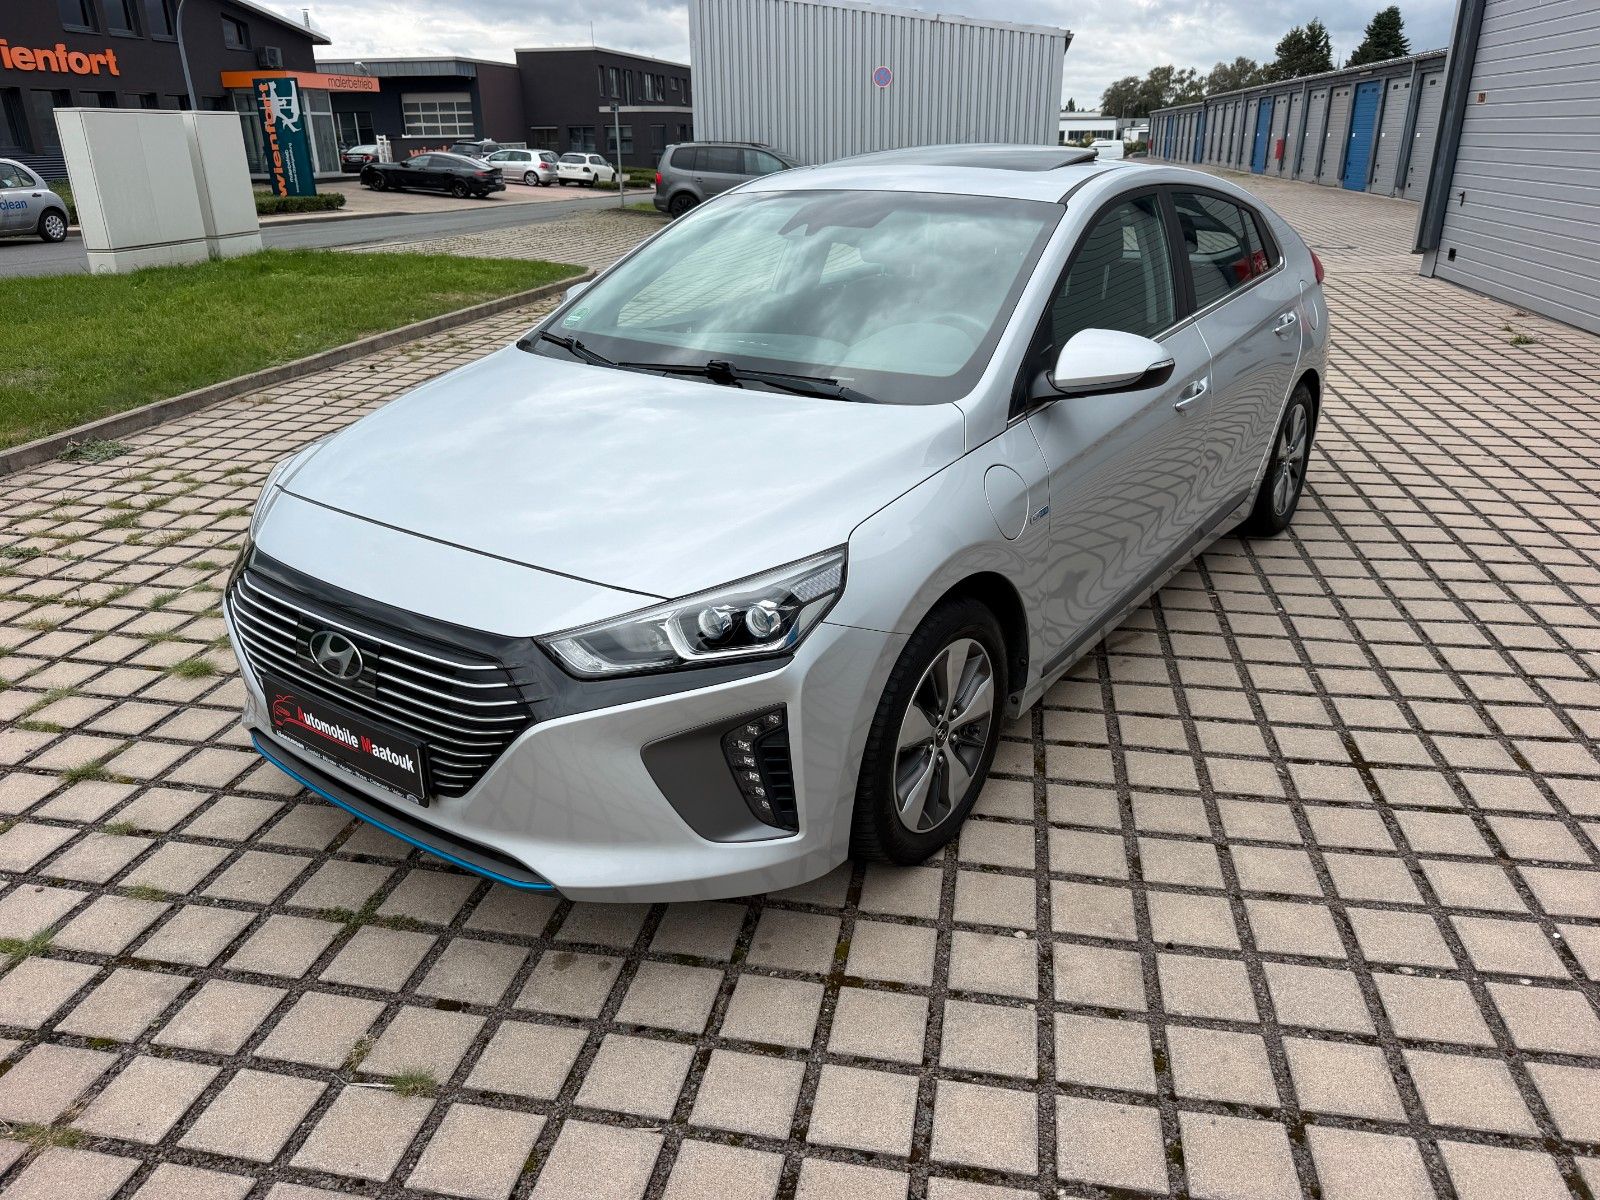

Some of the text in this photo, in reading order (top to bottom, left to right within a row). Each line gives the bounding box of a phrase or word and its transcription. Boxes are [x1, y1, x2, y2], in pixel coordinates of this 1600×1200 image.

[0, 38, 120, 76] ienfort
[327, 76, 373, 90] malerbetrieb
[258, 83, 288, 198] wienfort
[298, 705, 359, 748] Automobile
[361, 735, 415, 774] Maatouk
